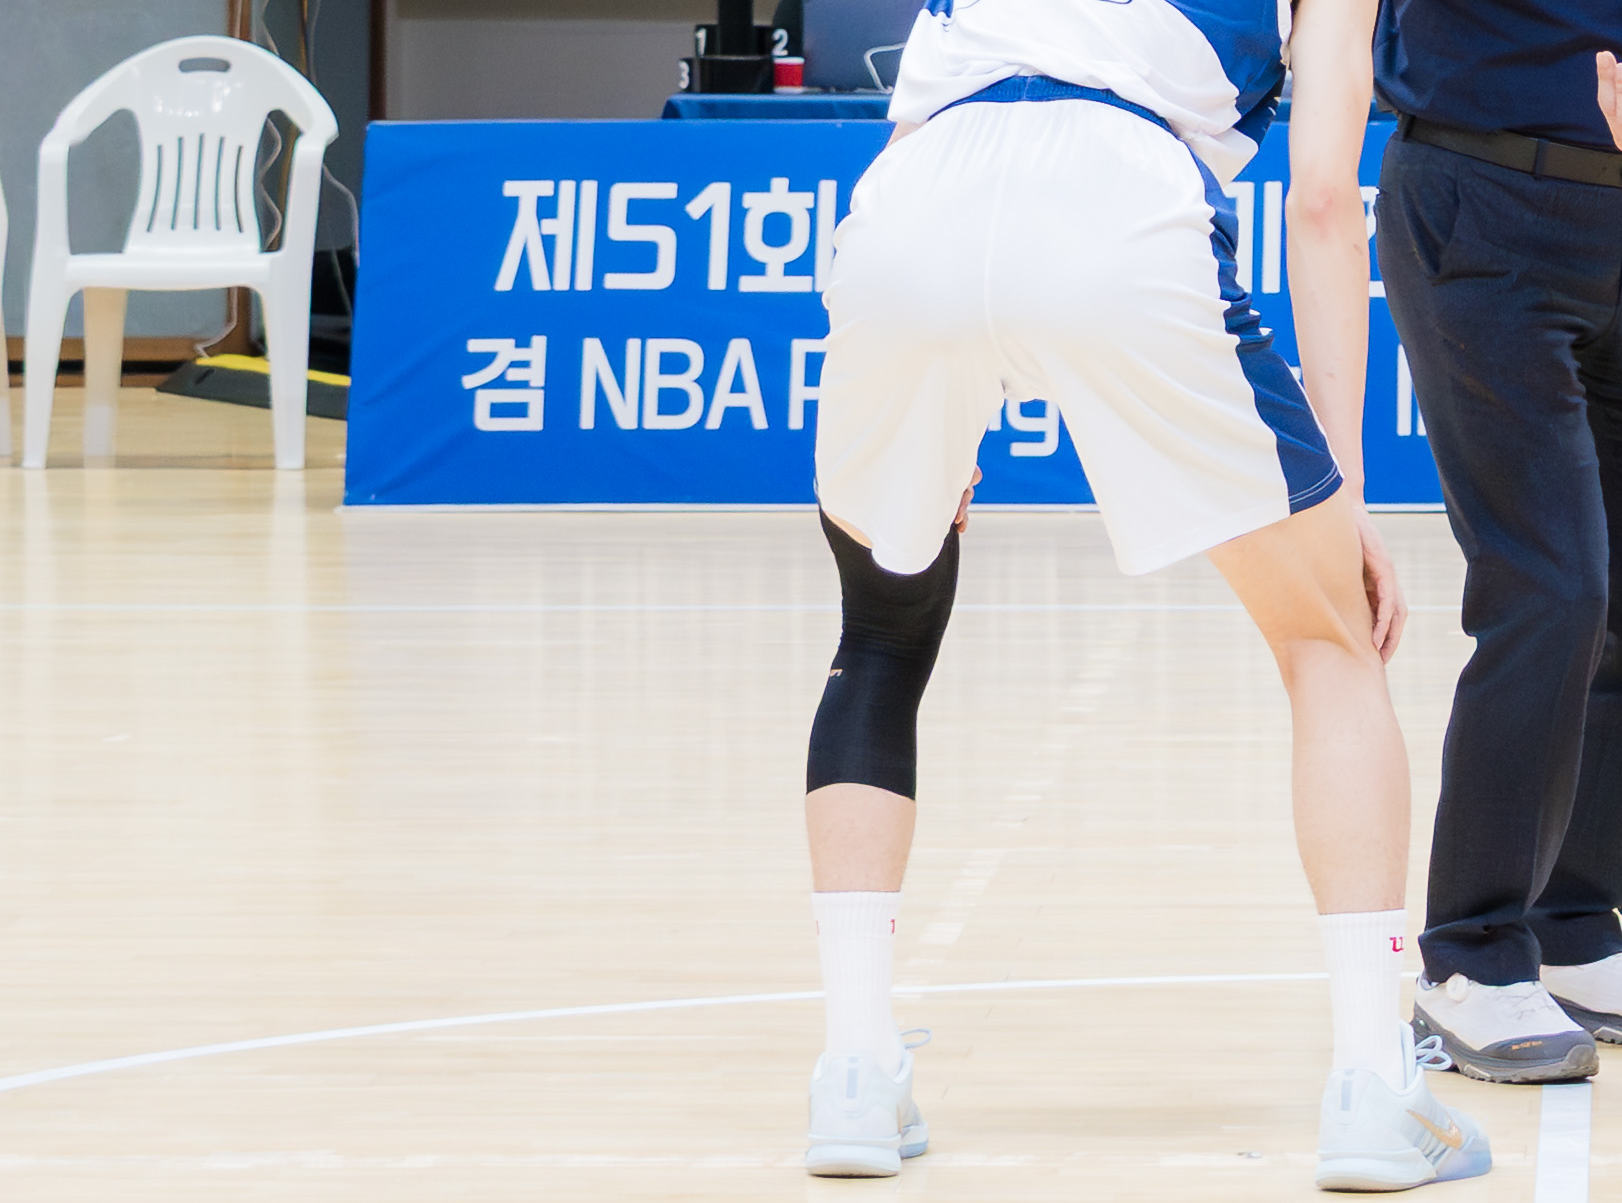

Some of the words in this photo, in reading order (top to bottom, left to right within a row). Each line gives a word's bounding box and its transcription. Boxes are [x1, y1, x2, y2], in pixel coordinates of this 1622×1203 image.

[772, 29, 788, 56] 2
[495, 176, 837, 294] 제51회
[461, 334, 548, 433] 겸
[579, 337, 769, 431] NBA
